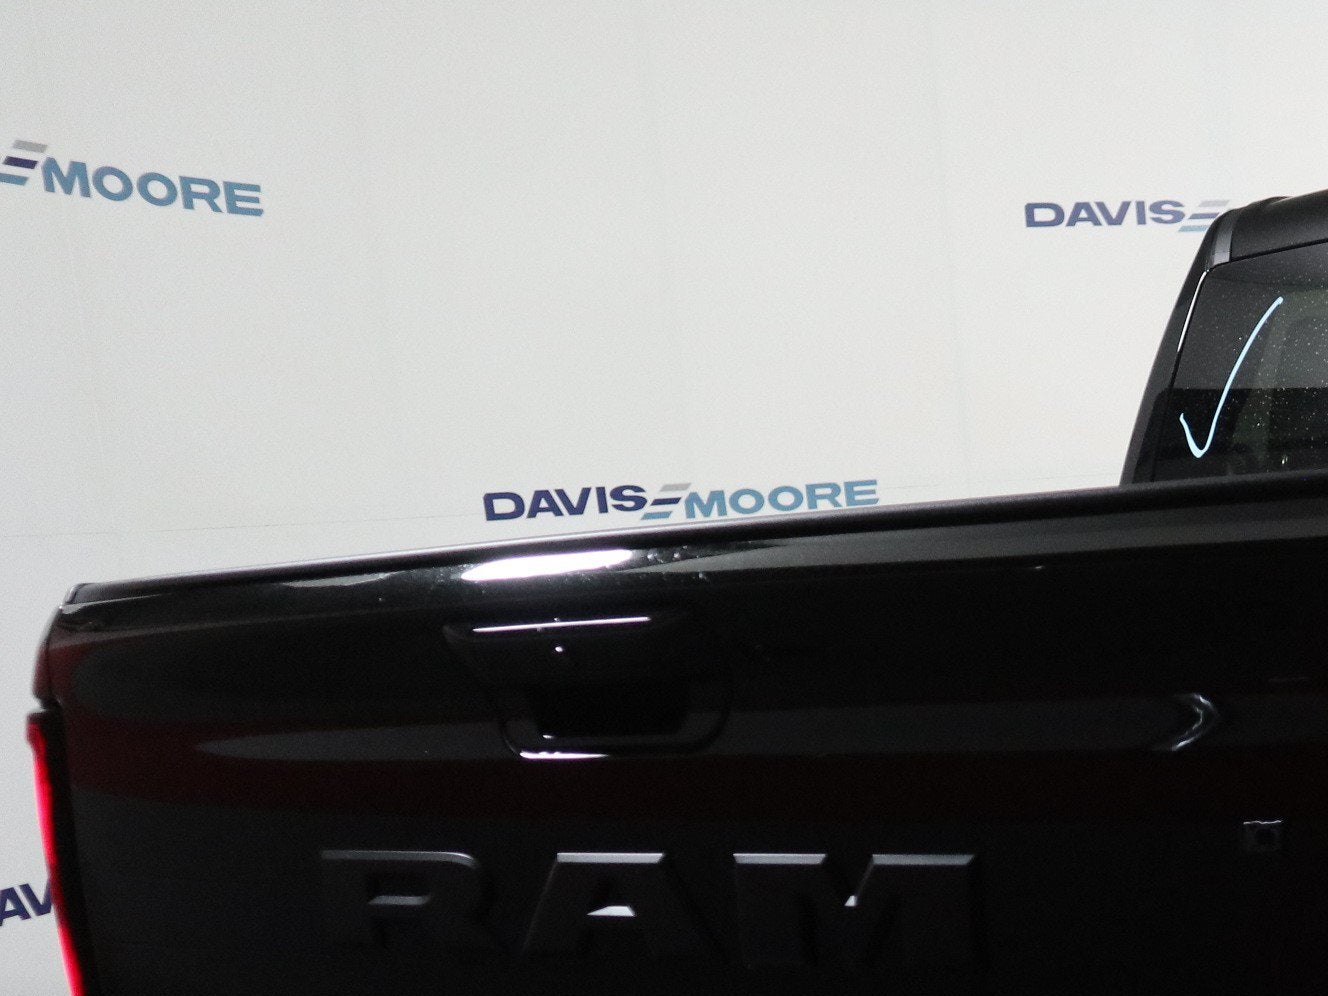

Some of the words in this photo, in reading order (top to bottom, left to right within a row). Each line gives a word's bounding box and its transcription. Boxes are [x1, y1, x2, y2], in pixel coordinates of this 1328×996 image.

[41, 156, 264, 217] MOORE
[1024, 200, 1185, 228] DAVIS
[482, 484, 647, 522] DAVIS
[684, 479, 880, 518] MOORE
[0, 880, 53, 927] AV
[320, 849, 977, 970] RAM
